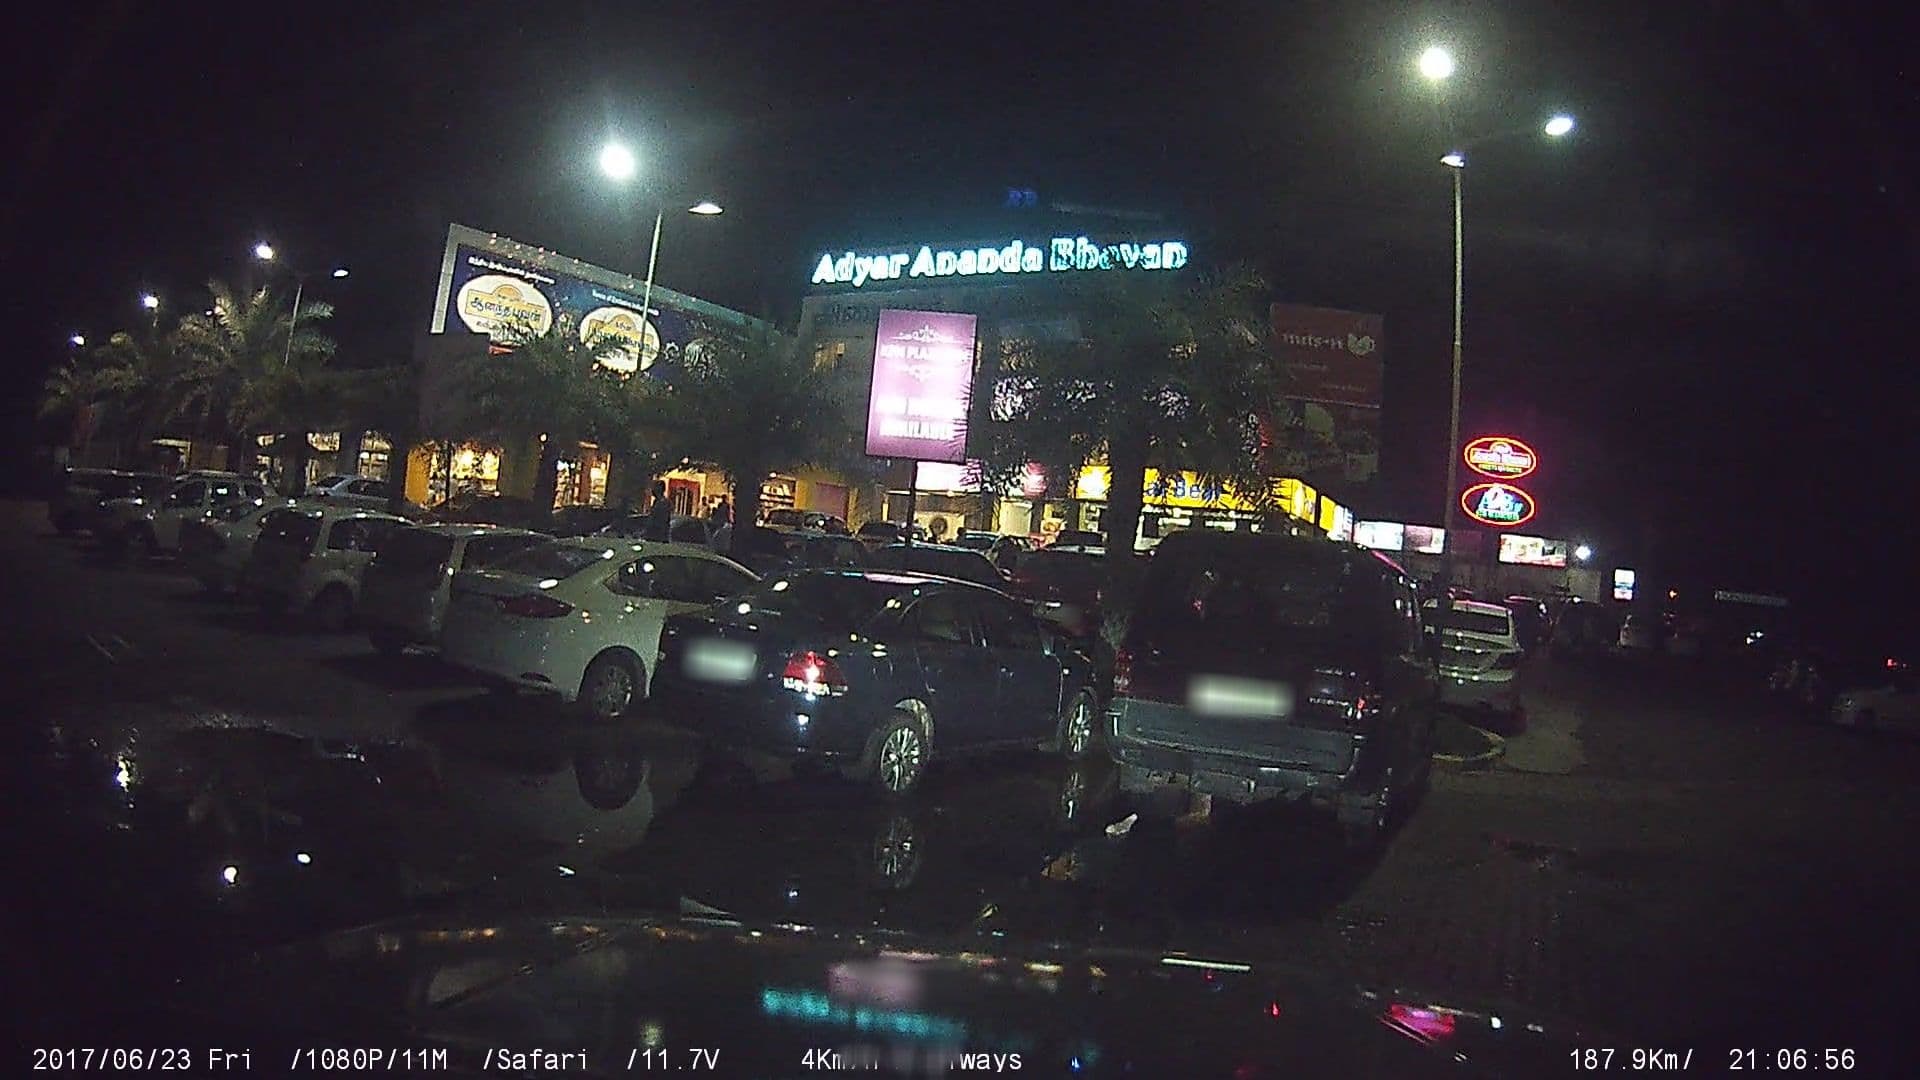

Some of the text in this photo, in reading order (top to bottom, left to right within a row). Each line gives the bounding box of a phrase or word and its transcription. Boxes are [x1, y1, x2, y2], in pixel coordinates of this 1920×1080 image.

[811, 236, 1188, 288] Adyar Ananda Bhavan
